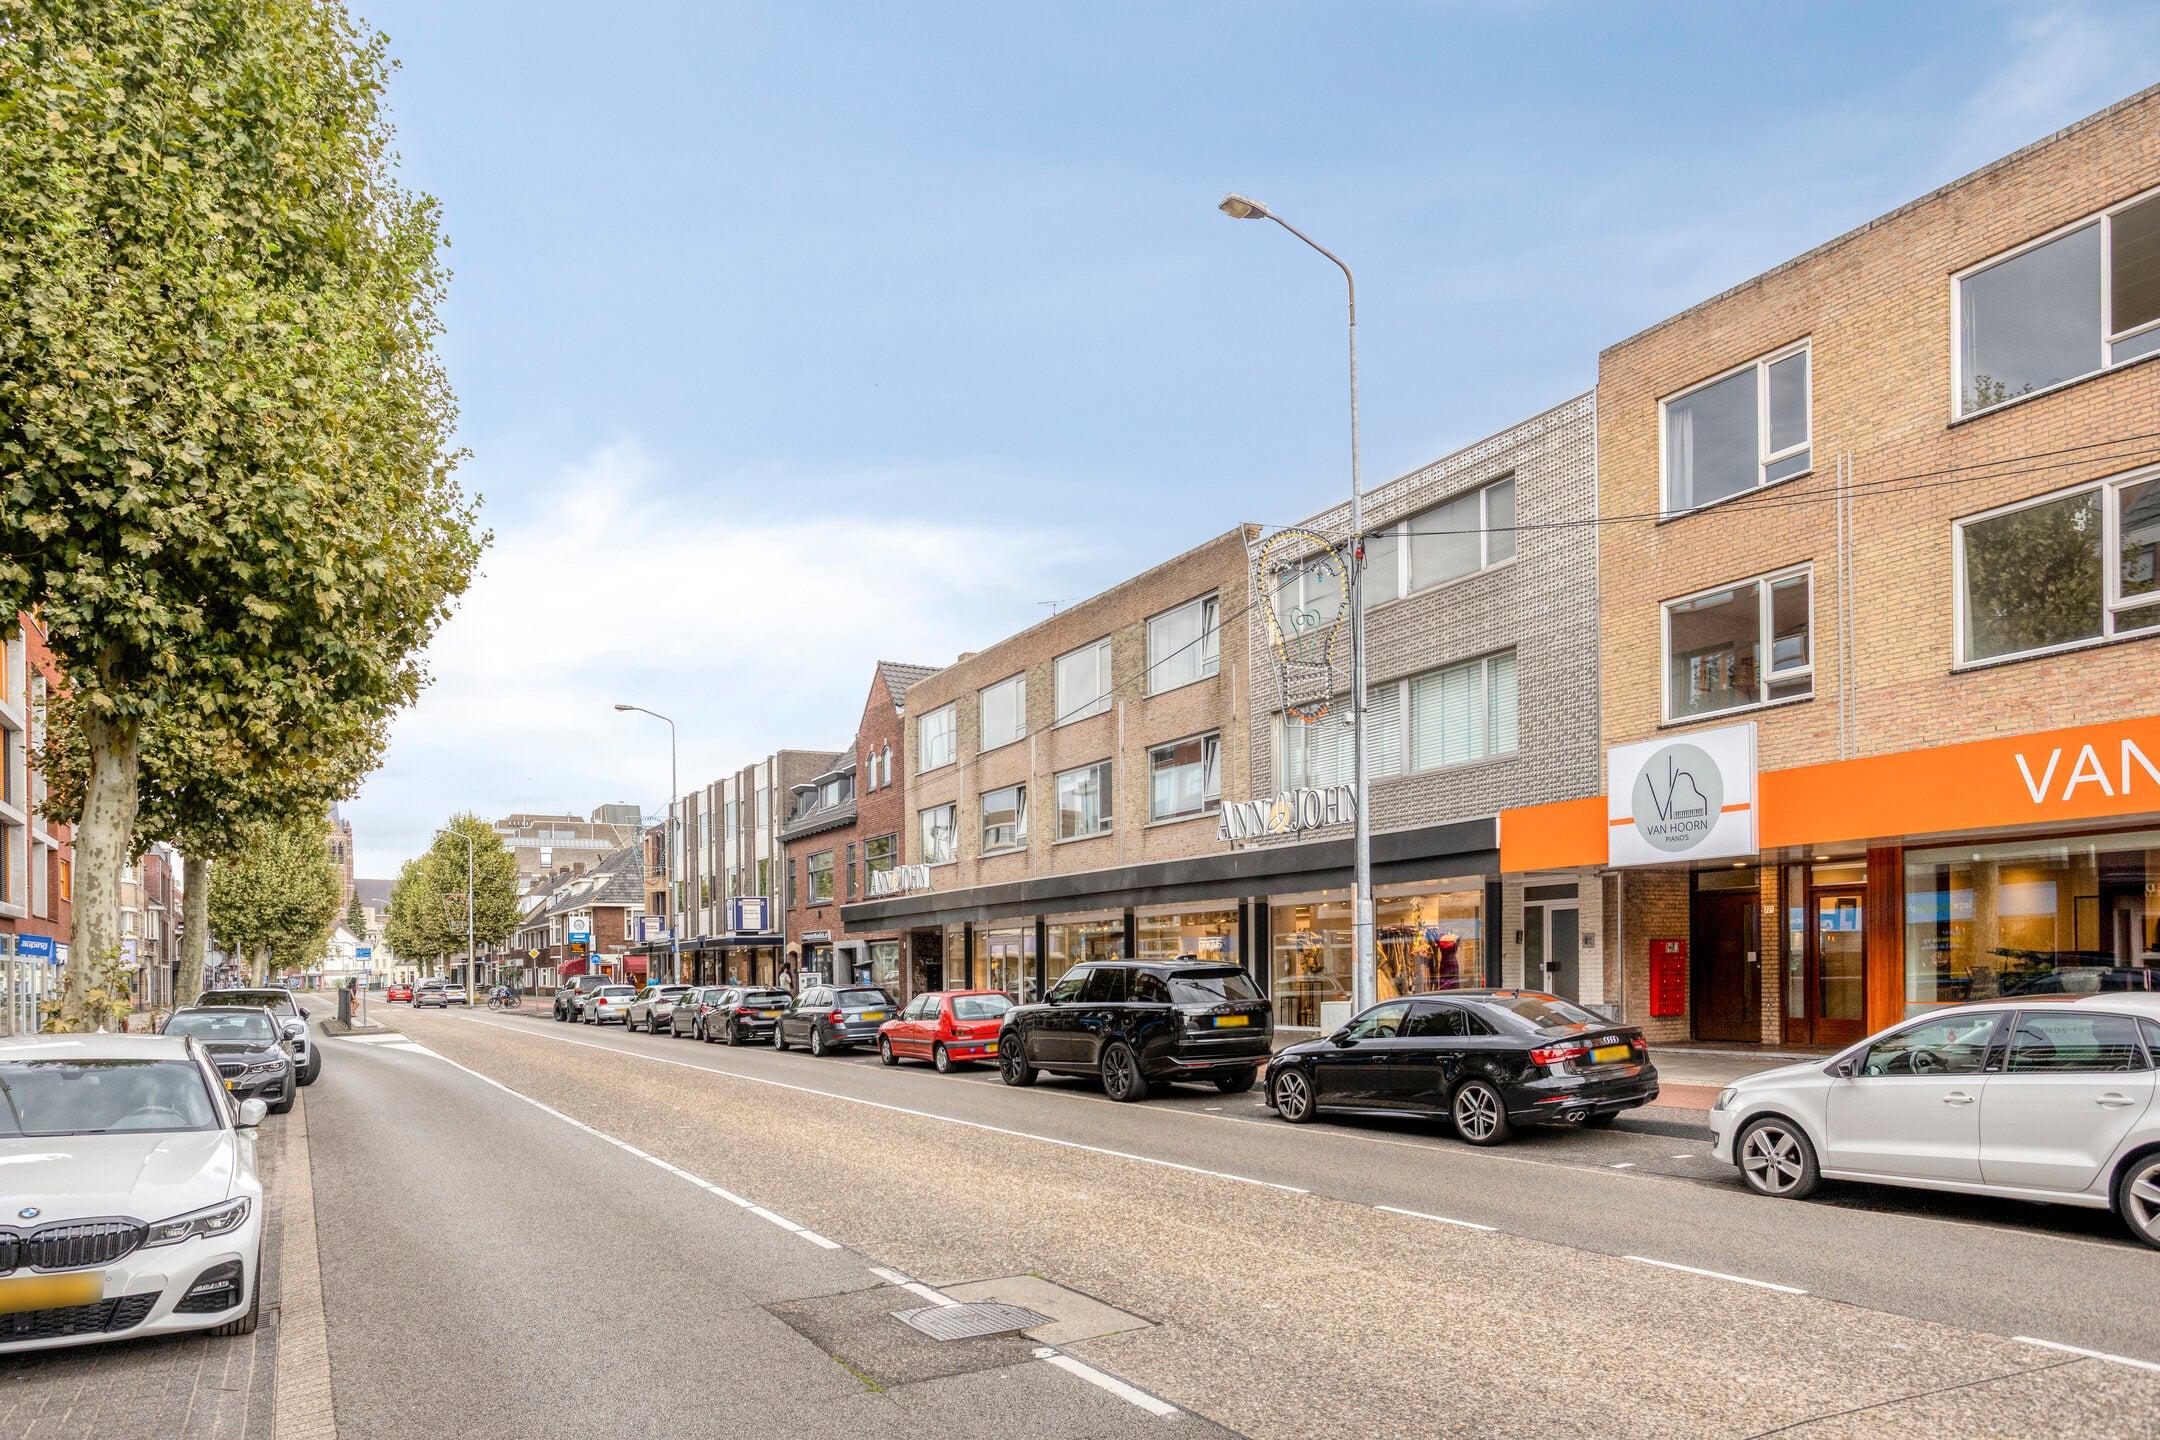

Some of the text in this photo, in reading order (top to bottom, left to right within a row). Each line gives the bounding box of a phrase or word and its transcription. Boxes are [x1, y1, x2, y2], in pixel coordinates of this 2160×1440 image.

[2014, 738, 2160, 804] VAN
[1216, 800, 1270, 842] ANN
[1647, 820, 1708, 835] VAN HOORN
[1666, 834, 1689, 842] PIANO'S
